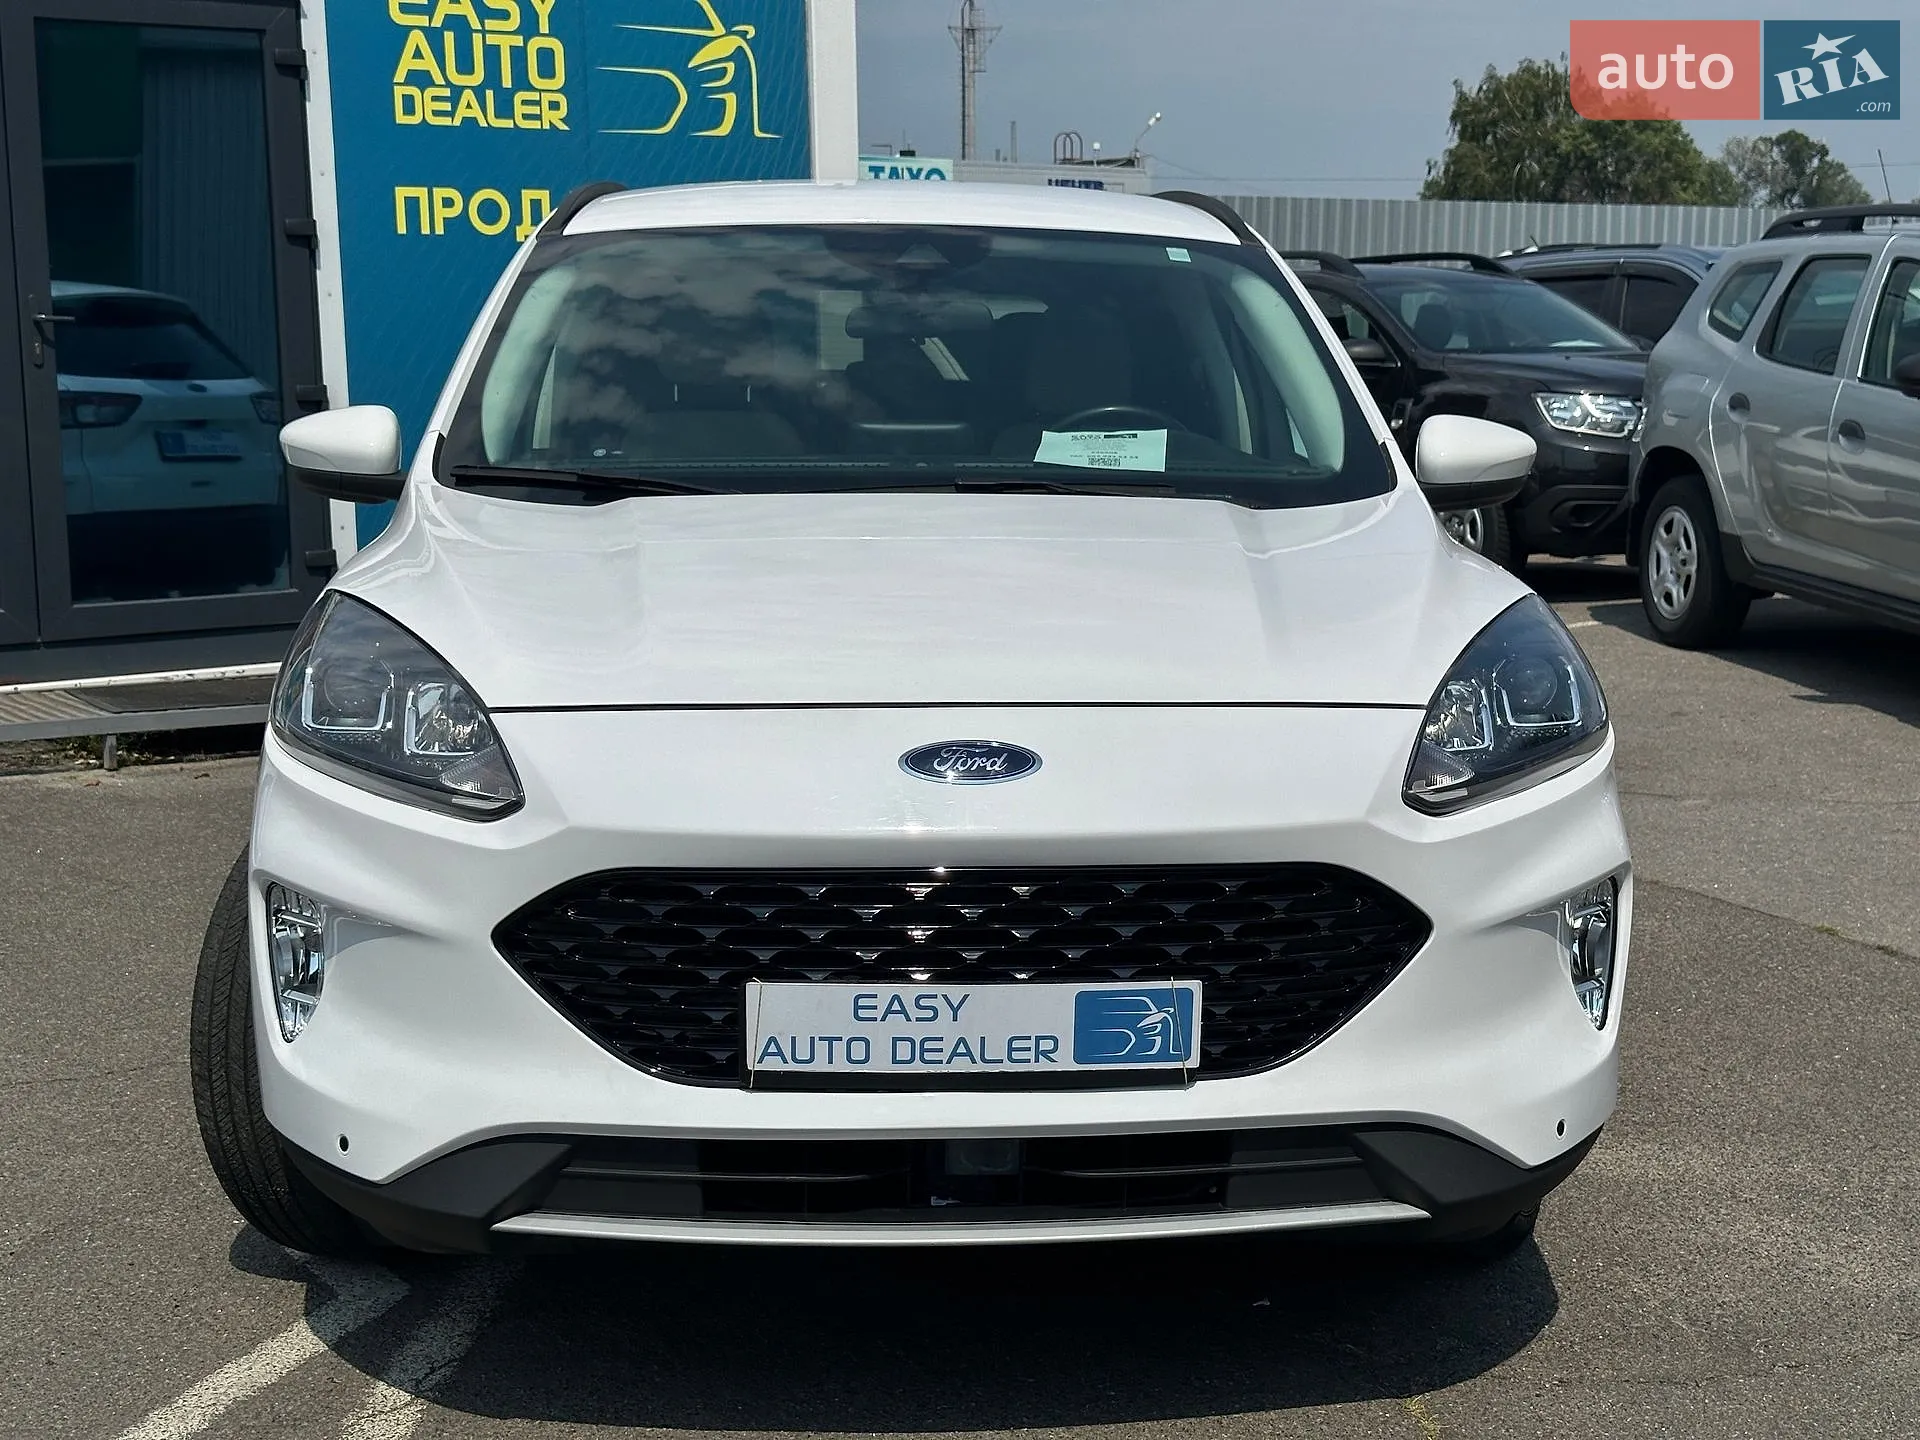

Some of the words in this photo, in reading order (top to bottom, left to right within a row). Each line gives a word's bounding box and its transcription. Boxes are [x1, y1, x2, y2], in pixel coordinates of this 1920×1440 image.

[393, 29, 566, 91] AUTO
[393, 85, 570, 131] DEALER
[933, 746, 1008, 772] Ford
[852, 993, 970, 1023] EASY
[757, 1035, 872, 1065] AUTO
[891, 1034, 1060, 1064] DEALER
